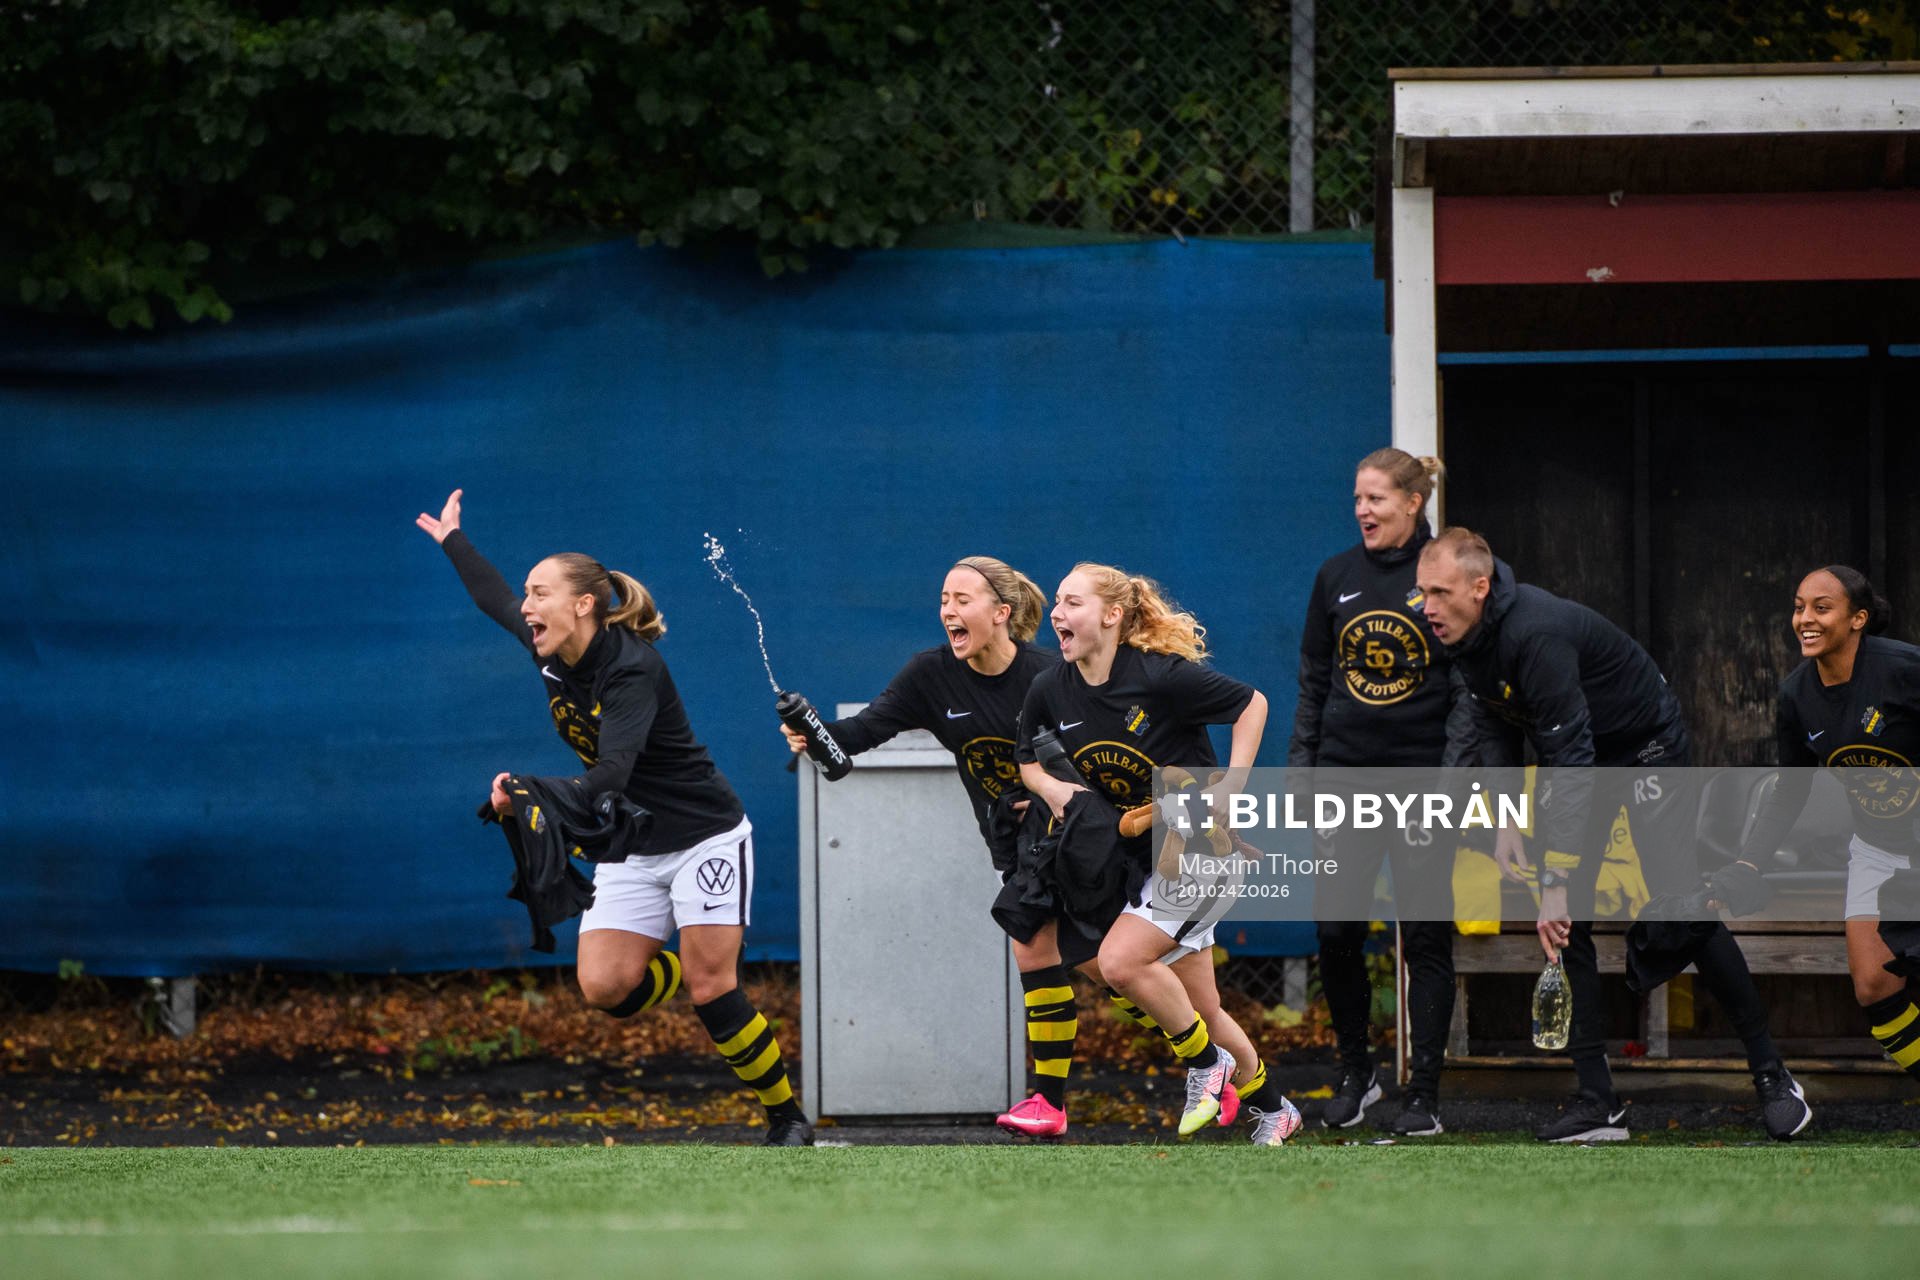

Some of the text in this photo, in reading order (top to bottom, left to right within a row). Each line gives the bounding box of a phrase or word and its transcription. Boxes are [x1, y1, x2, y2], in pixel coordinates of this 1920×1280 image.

[1366, 620, 1419, 662] TILLBAKA
[1347, 669, 1367, 690] AIK
[804, 708, 847, 765] stadium
[1634, 774, 1663, 805] RS
[1404, 819, 1433, 847] CS
